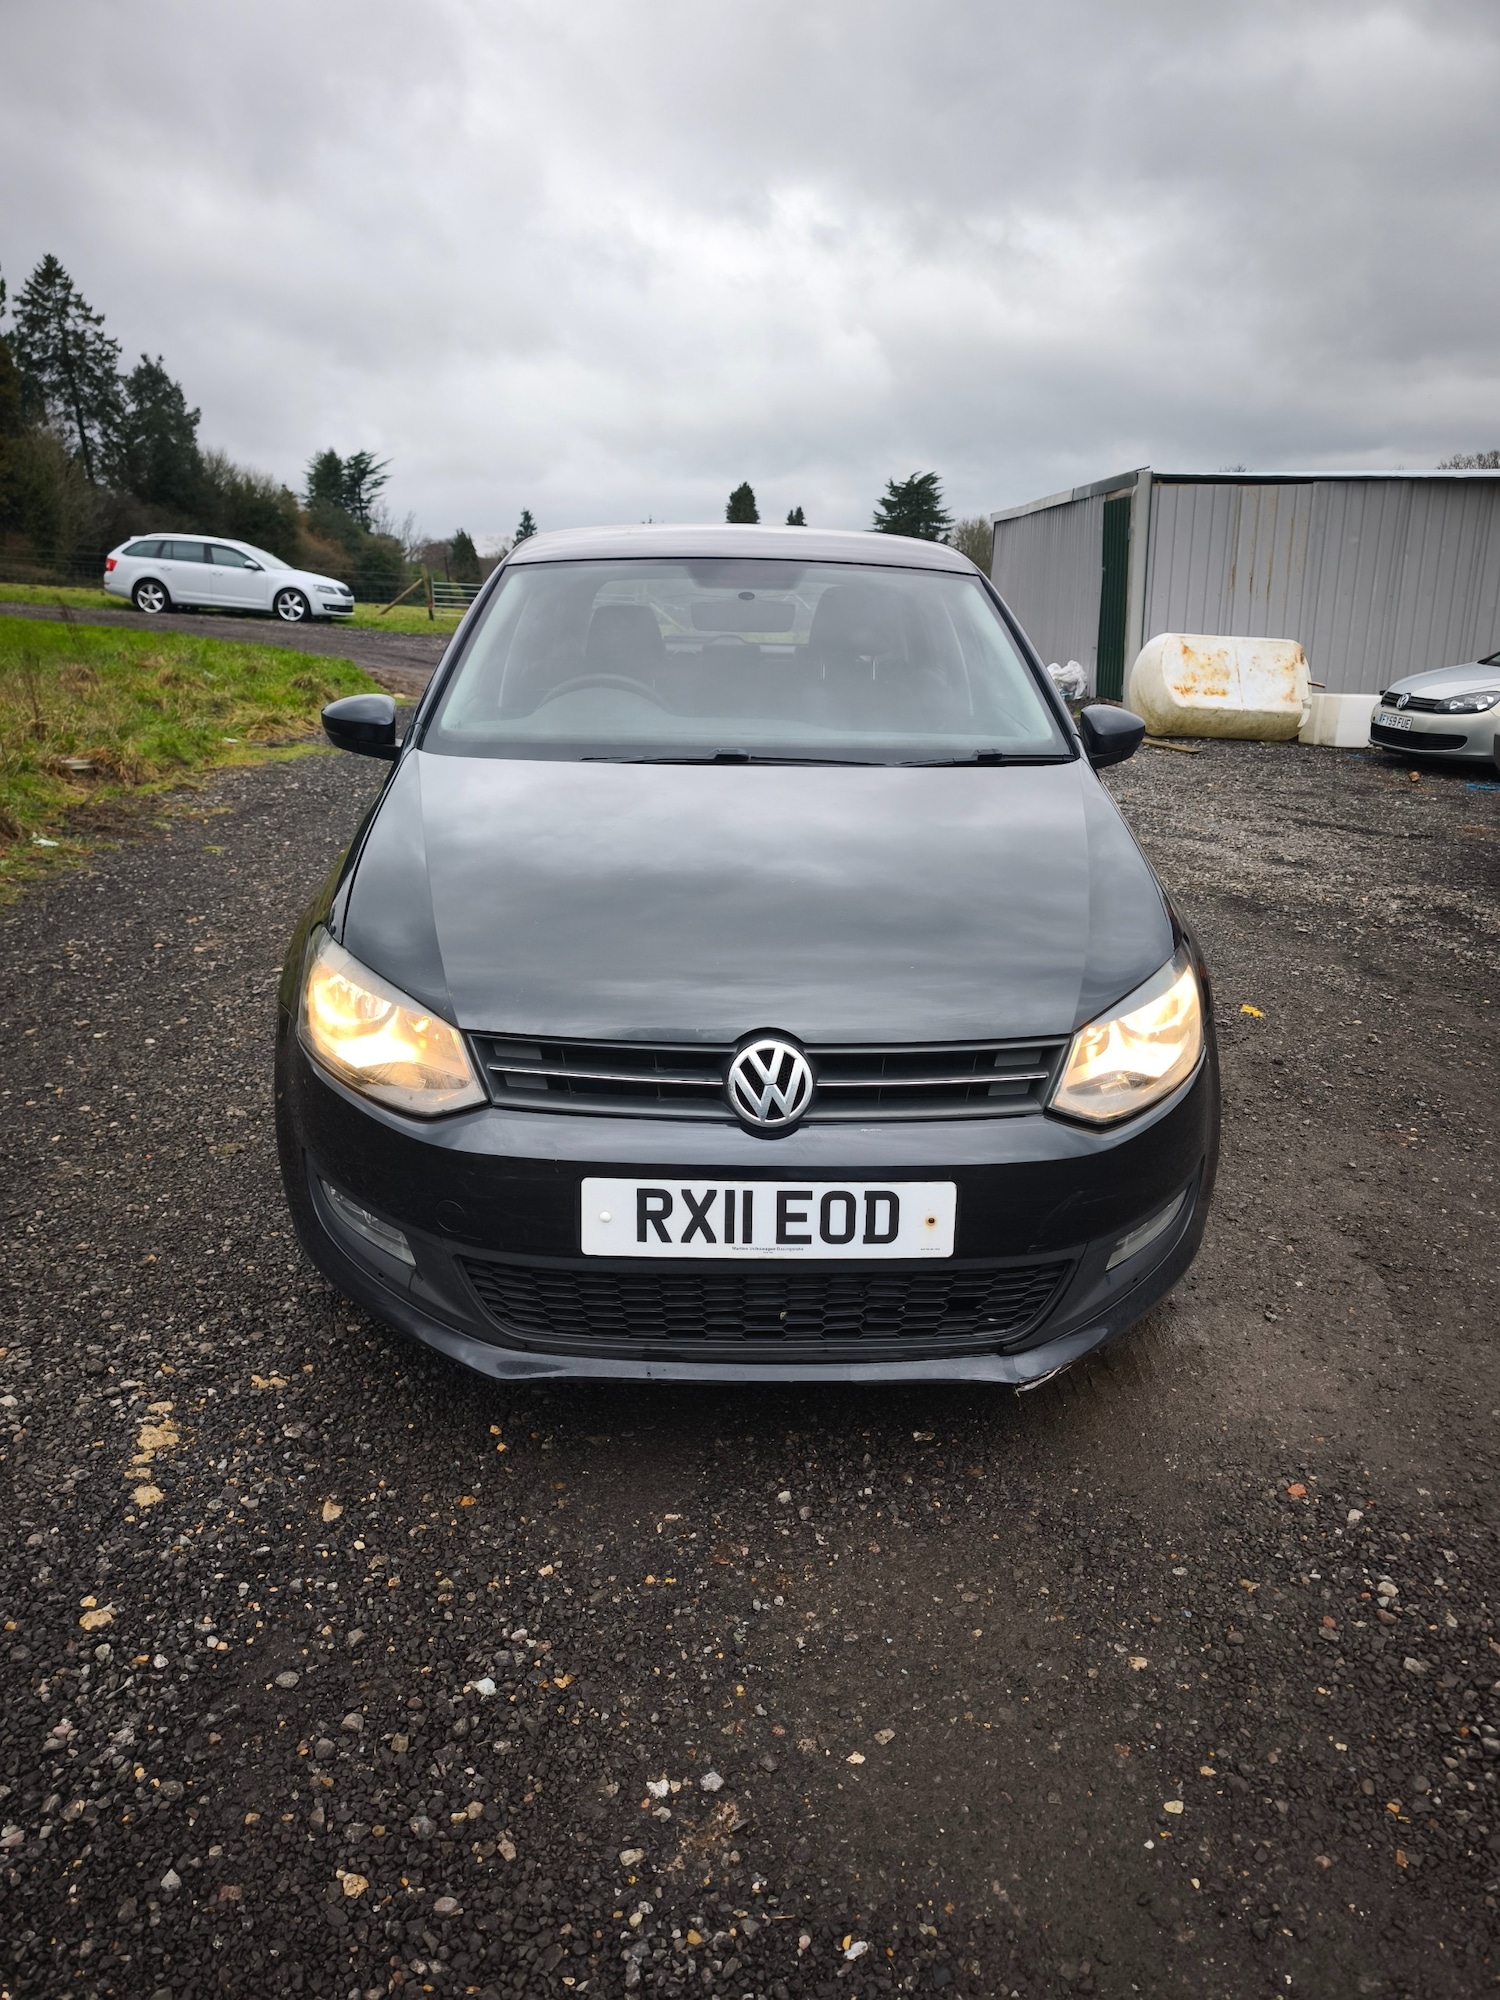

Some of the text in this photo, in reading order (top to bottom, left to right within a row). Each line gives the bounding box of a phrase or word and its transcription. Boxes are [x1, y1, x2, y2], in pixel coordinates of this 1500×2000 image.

[1382, 714, 1411, 729] FY59 FUE
[728, 1039, 813, 1127] VW
[636, 1188, 900, 1245] RX11 EOD
